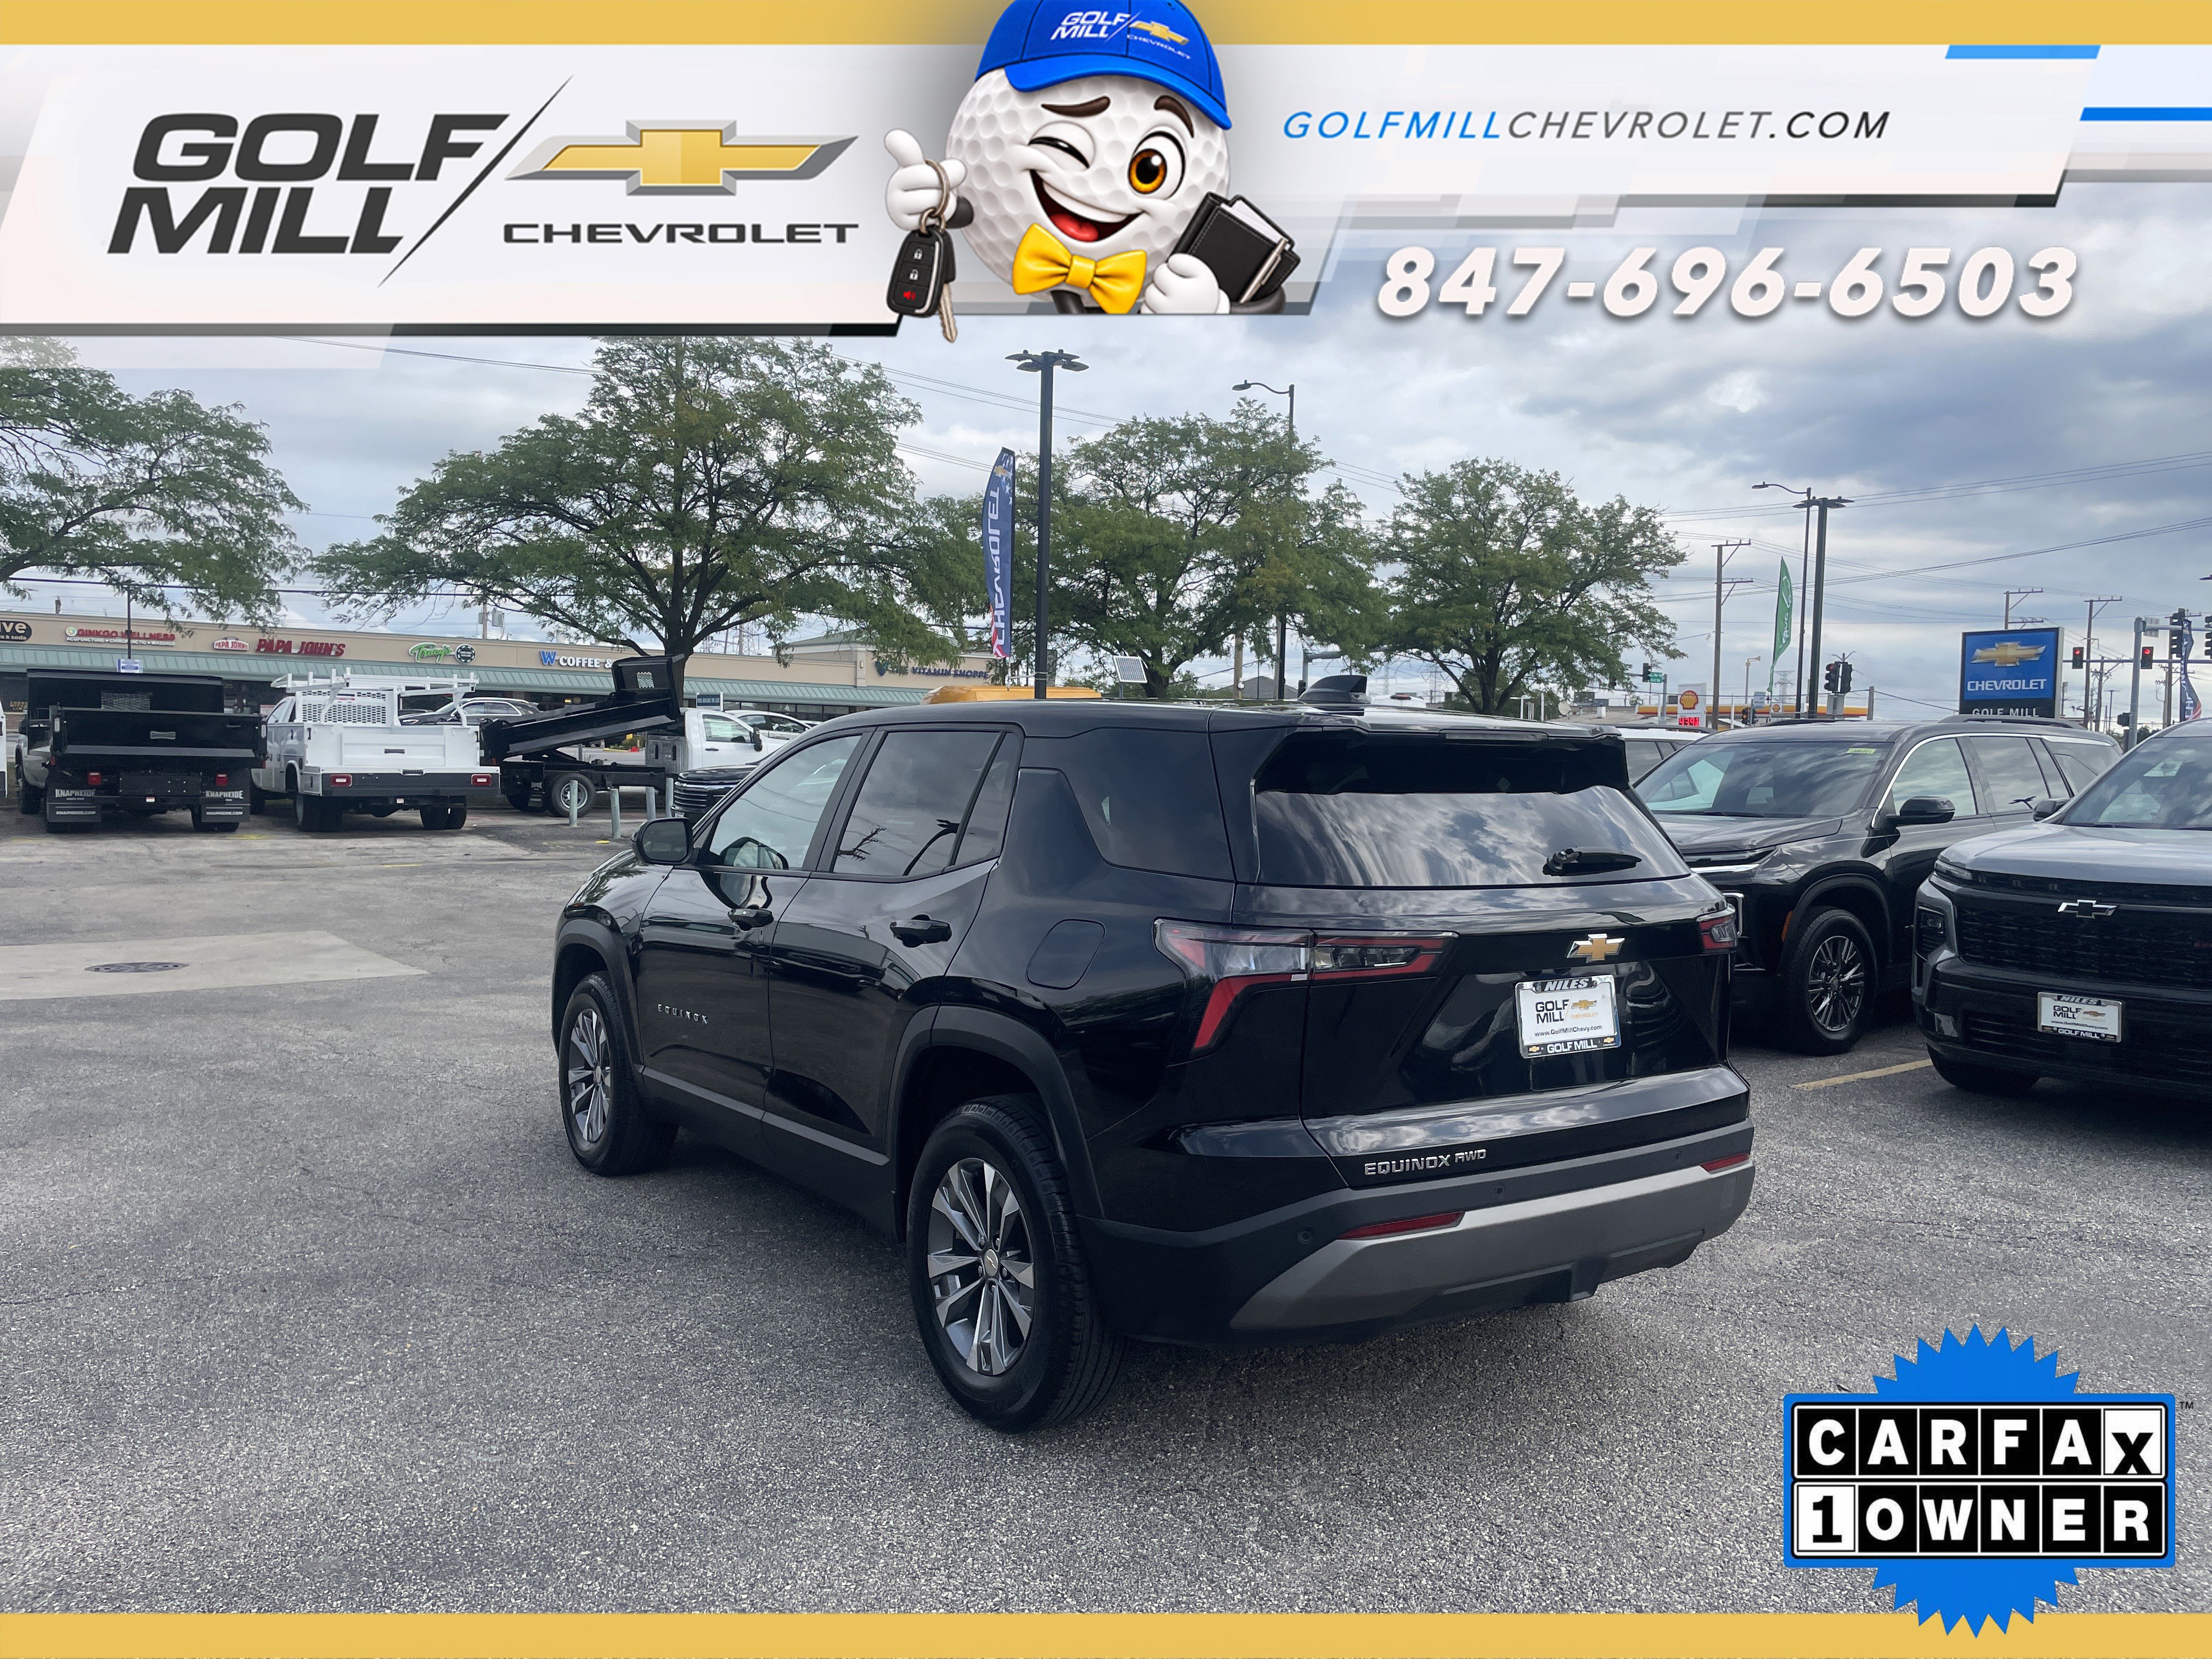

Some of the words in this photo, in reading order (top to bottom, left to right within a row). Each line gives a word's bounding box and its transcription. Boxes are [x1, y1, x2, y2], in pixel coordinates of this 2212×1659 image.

[0, 622, 27, 634] ve
[256, 639, 292, 653] PAPA
[297, 641, 346, 657] JOHN'S
[559, 655, 601, 668] COFFEE
[605, 658, 613, 668] &
[912, 667, 951, 676] VITAMIN
[1967, 679, 2047, 691] CHEVROLET
[2010, 708, 2040, 717] MILL
[55, 789, 96, 798] KNAPHEIDE
[206, 790, 244, 799] KNAPHEIDE
[1544, 978, 1590, 991] NILES
[1535, 999, 1569, 1012] GOLF
[2061, 996, 2098, 1005] NILES
[658, 1004, 709, 1024] EQUINOX
[2053, 1005, 2082, 1014] GOLF
[2053, 1011, 2076, 1019] MILL
[1537, 1011, 1565, 1024] MILL
[1534, 1025, 1602, 1037] www.GolfMillChevy.com
[1547, 1042, 1572, 1053] GOLF
[1574, 1039, 1598, 1050] MILL
[1364, 1154, 1451, 1175] EQUINOX
[1454, 1149, 1487, 1163] AWD
